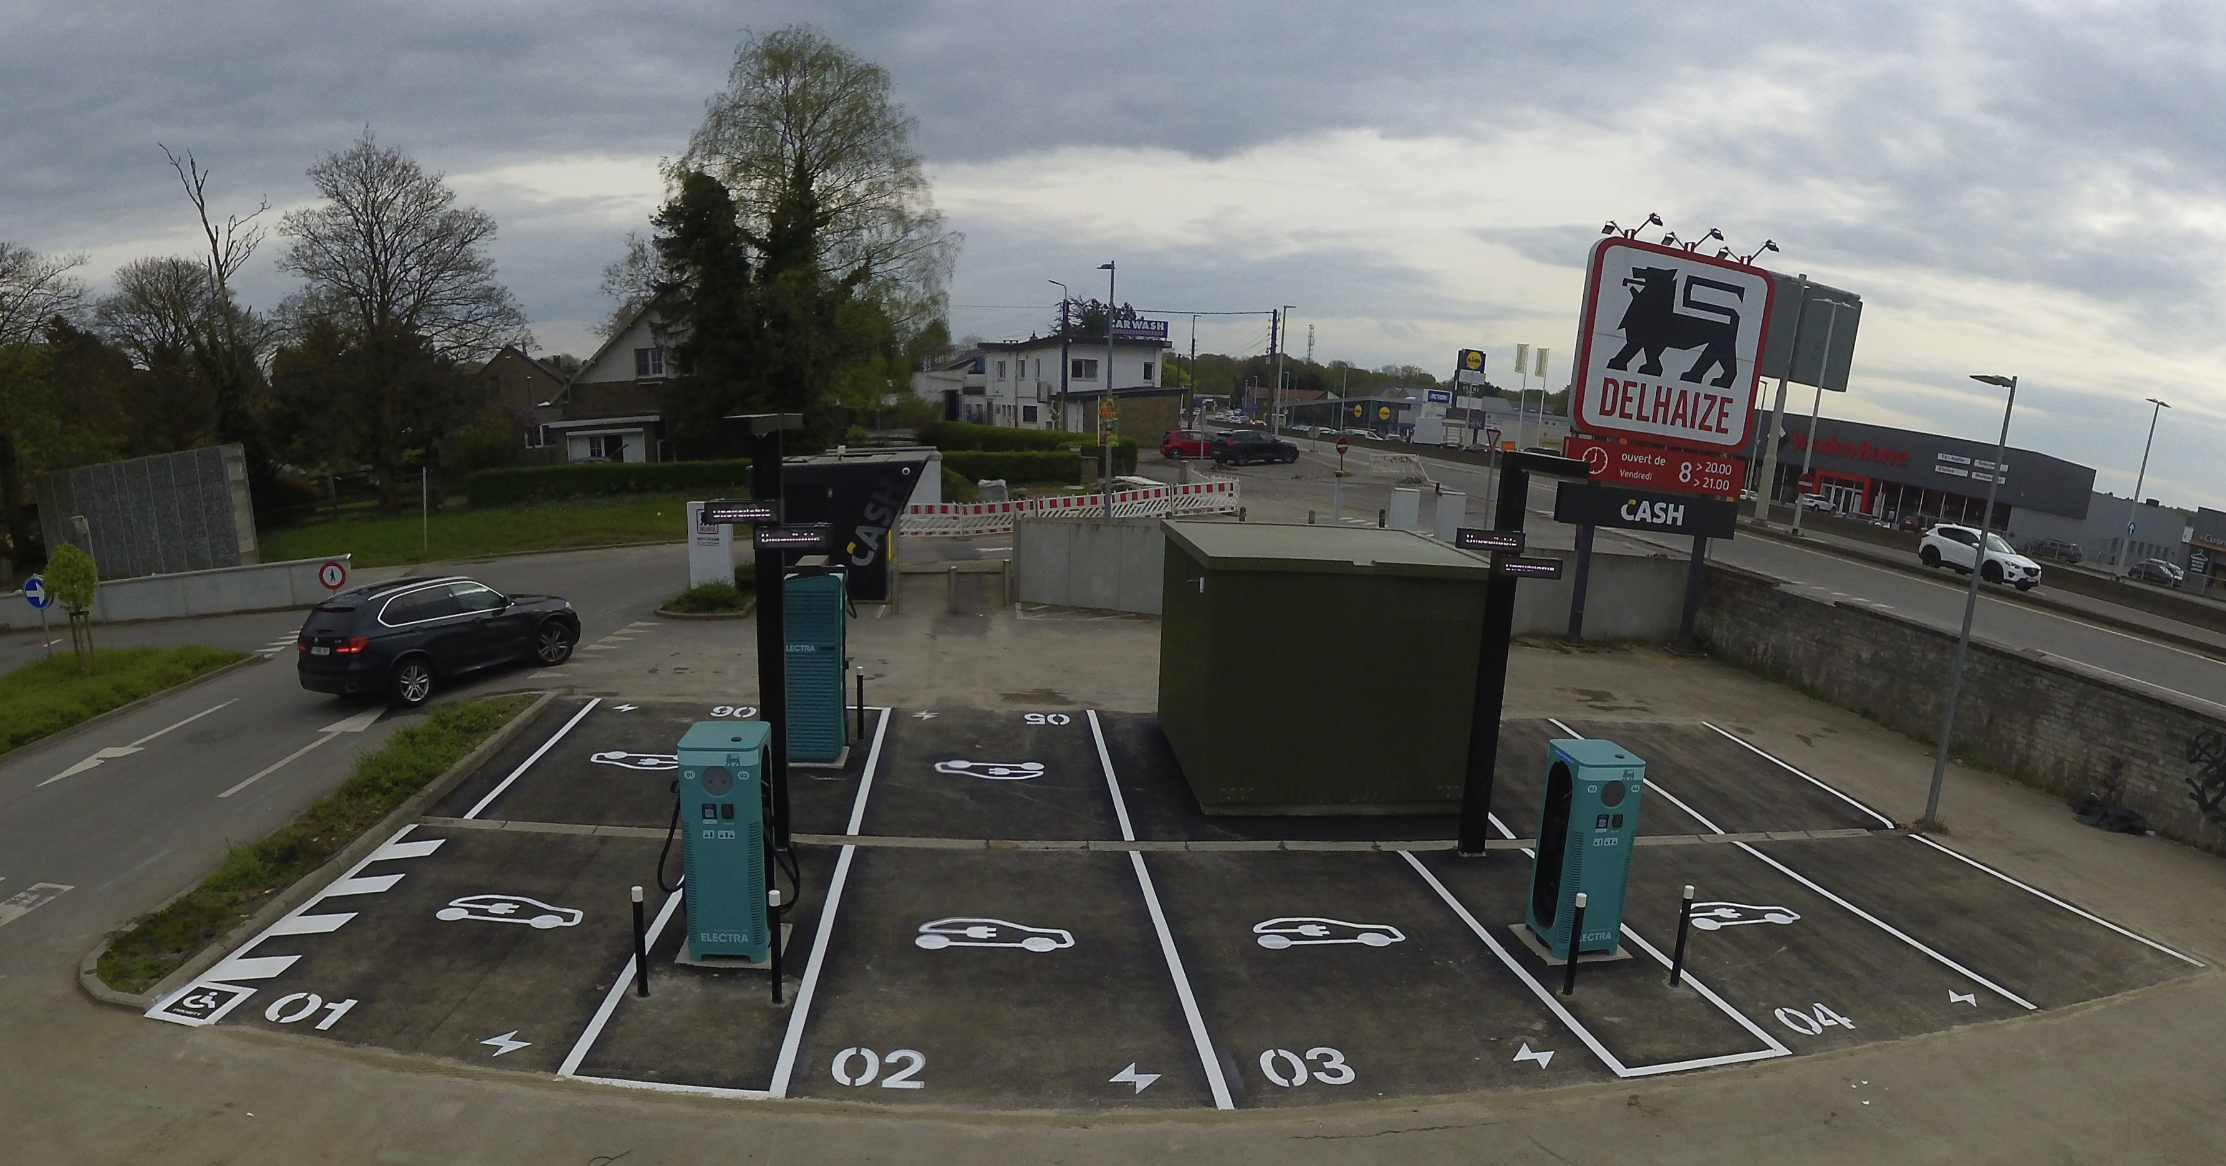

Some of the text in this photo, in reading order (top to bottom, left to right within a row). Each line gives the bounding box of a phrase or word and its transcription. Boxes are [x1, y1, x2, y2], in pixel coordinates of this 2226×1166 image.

[1112, 319, 1164, 331] AR WASH
[1599, 377, 1734, 435] DELHAIZE
[1621, 453, 1666, 466] ouvert de
[1705, 462, 1732, 476] 20.00
[1619, 469, 1653, 481] Vendredi
[1678, 461, 1692, 483] 8
[1703, 477, 1730, 491] 21.00
[846, 478, 902, 567] CASH
[1620, 498, 1685, 526] CASH
[786, 644, 815, 653] LECTRA
[700, 932, 749, 943] ELECTRA
[265, 992, 358, 1030] 01
[1774, 1002, 1856, 1036] 04
[830, 1047, 926, 1090] 02
[1258, 1046, 1356, 1088] 03
